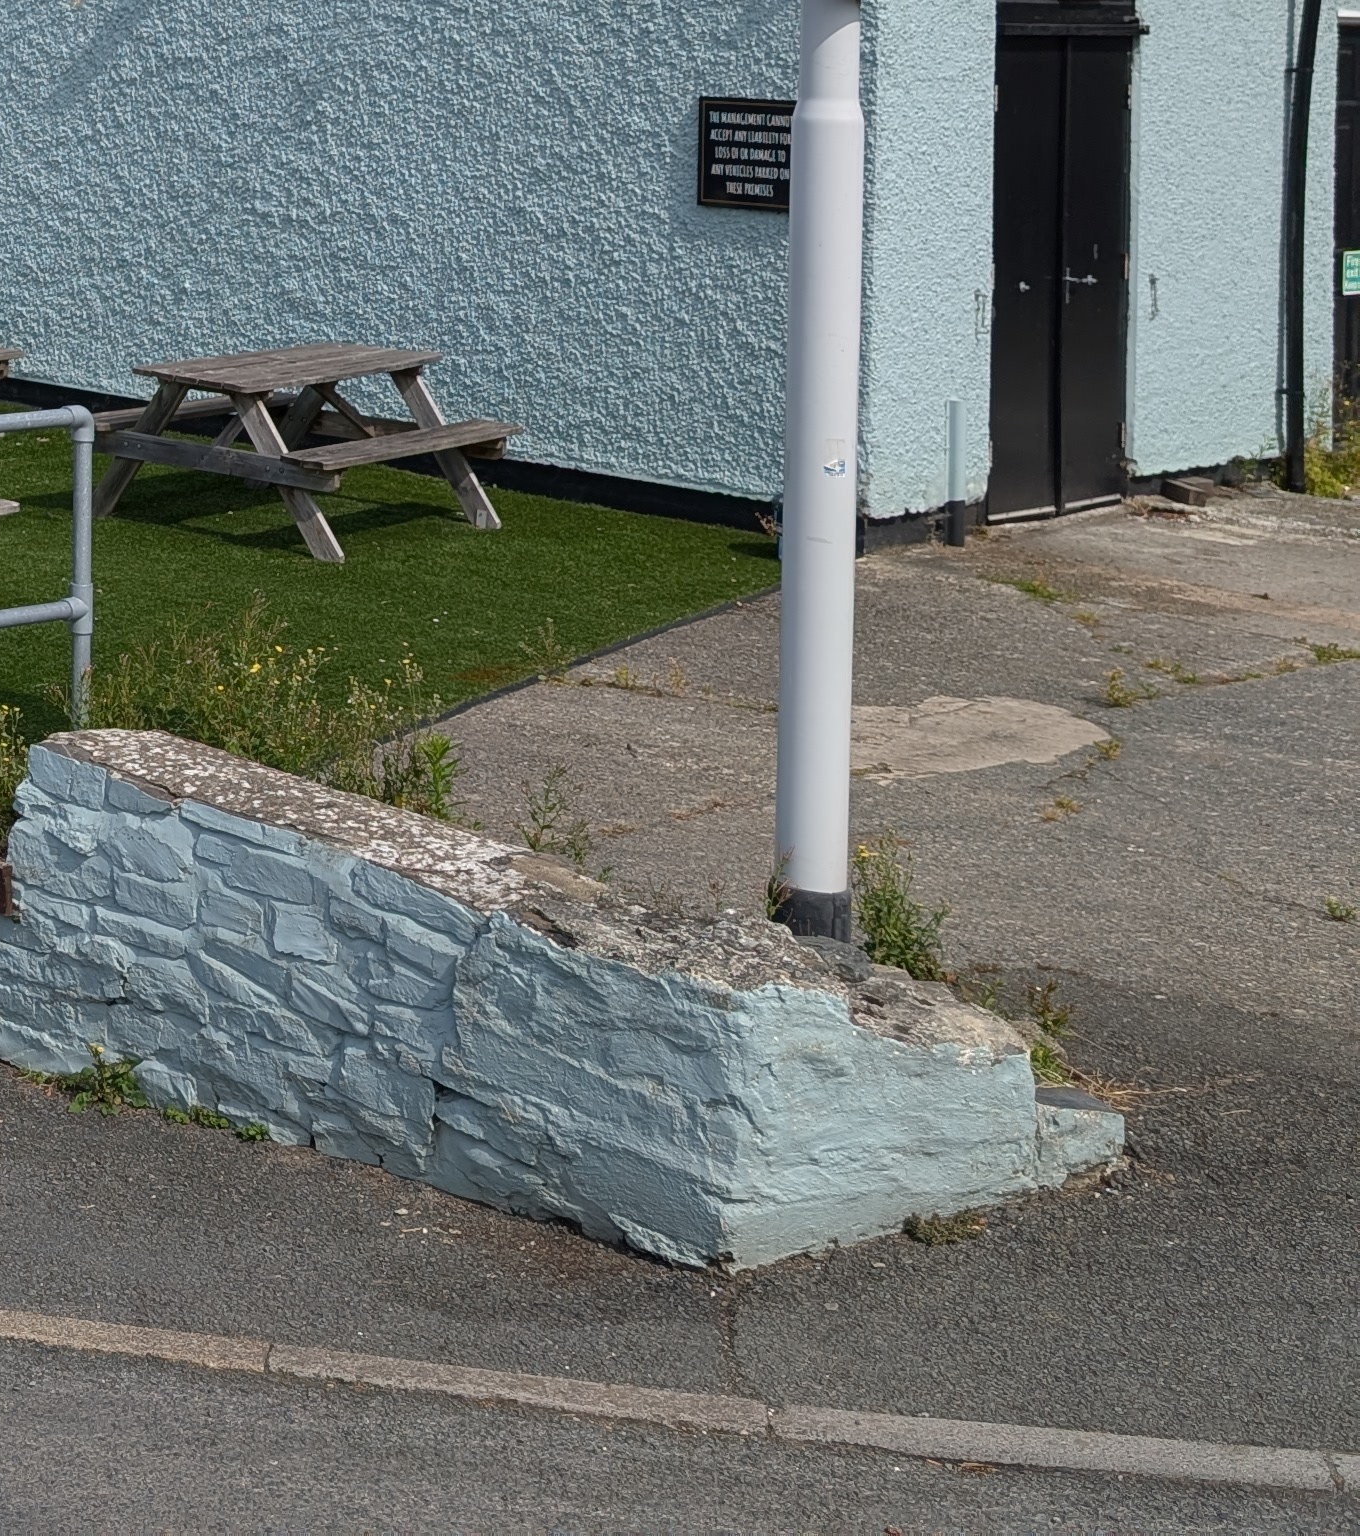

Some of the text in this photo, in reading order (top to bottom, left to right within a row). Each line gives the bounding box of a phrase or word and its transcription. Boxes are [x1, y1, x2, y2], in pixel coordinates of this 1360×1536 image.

[709, 111, 720, 124] THE
[721, 111, 766, 126] MANAGEMENT
[710, 128, 733, 142] ACCEPT
[734, 130, 747, 142] ANY
[748, 131, 779, 144] LIABILITY
[714, 146, 730, 159] LOSS
[740, 147, 748, 160] OR
[749, 148, 776, 162] DAMAGE
[777, 149, 786, 163] TO
[711, 163, 724, 176] ANY
[725, 164, 754, 178] VEHICLES
[755, 166, 778, 179] PARKED
[726, 181, 774, 197] THESE PREMISES
